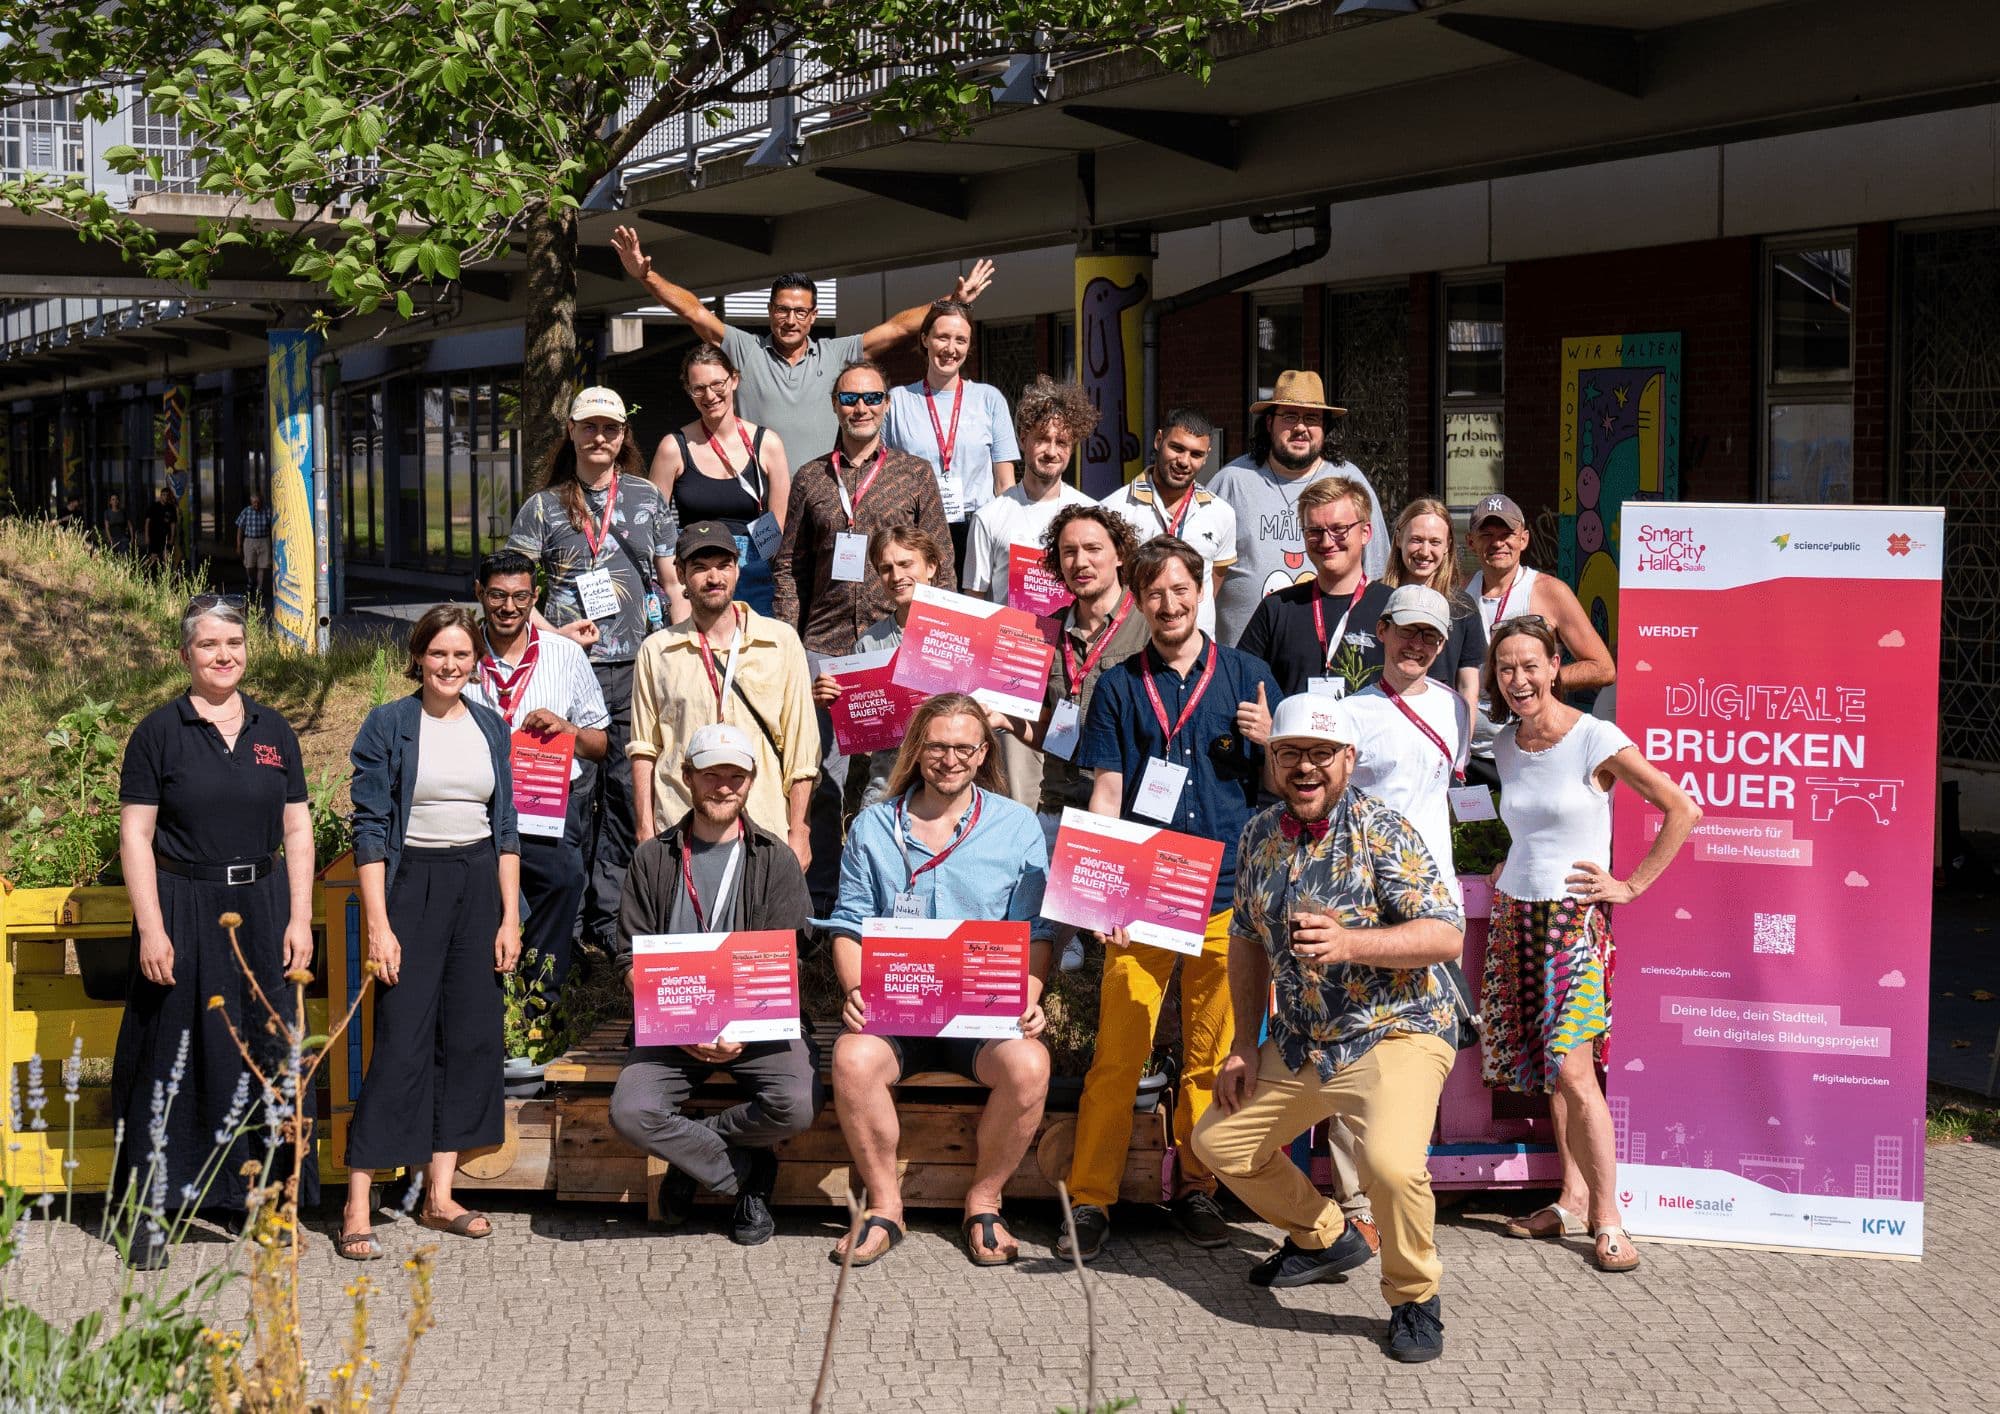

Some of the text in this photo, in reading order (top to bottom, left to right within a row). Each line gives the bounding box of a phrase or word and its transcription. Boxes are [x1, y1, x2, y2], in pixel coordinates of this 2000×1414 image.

[1567, 341, 1679, 359] WIR HALTEN
[1638, 525, 1693, 542] Smart
[1669, 542, 1706, 563] City
[1638, 554, 1706, 572] Halle Saale
[1638, 625, 1699, 638] WERDET
[921, 645, 954, 660] BAUER
[1665, 677, 1866, 723] DIGITALE
[850, 708, 878, 719] BAUER
[1660, 771, 1796, 810] AUER
[1765, 826, 1783, 838] für
[1706, 843, 1801, 859] Halle-Neustadt
[1072, 874, 1106, 890] BAUER
[1640, 965, 1731, 979] science2public.com
[884, 983, 919, 993] BAUER
[657, 994, 692, 1005] BAUER
[1671, 1003, 1828, 1026] Deine Idee, dein Stadtteil,
[1693, 1026, 1879, 1048] dein digitales Bildungsprojekt!
[1812, 1072, 1890, 1086] #digitalebrücken
